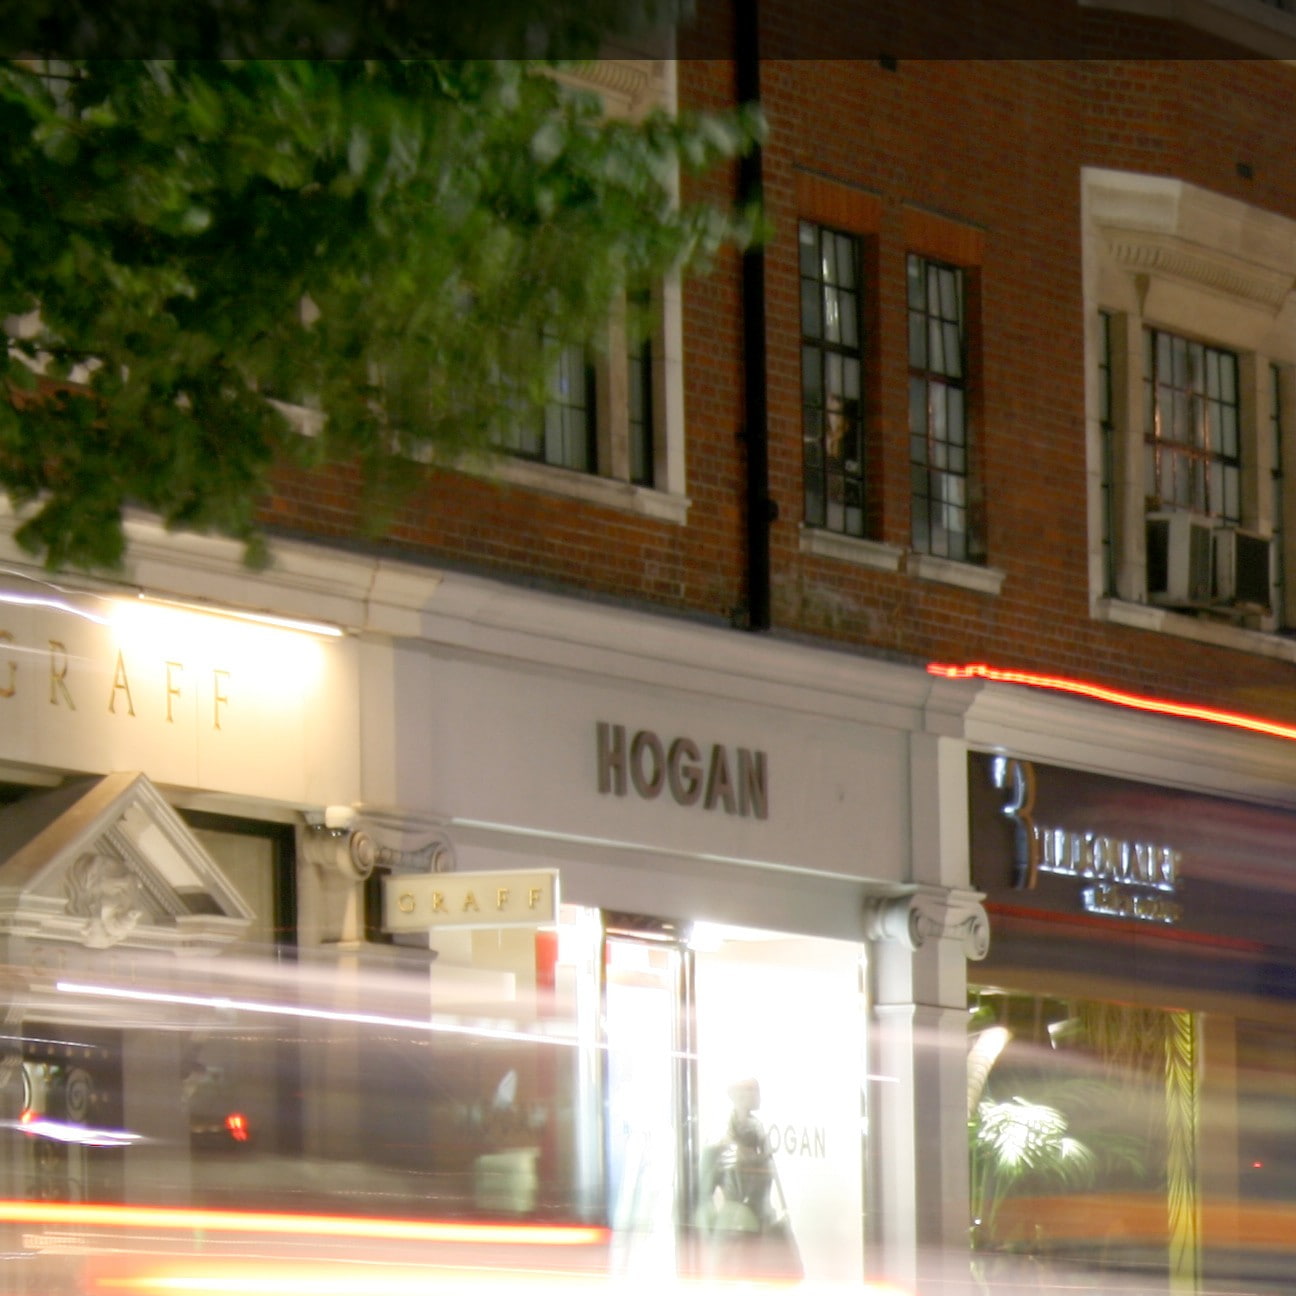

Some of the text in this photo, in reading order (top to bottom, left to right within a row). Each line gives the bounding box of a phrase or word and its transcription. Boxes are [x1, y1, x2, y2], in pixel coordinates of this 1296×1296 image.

[596, 720, 769, 821] HOGAN
[398, 887, 543, 913] GRAFF
[767, 1123, 826, 1159] OGAN
